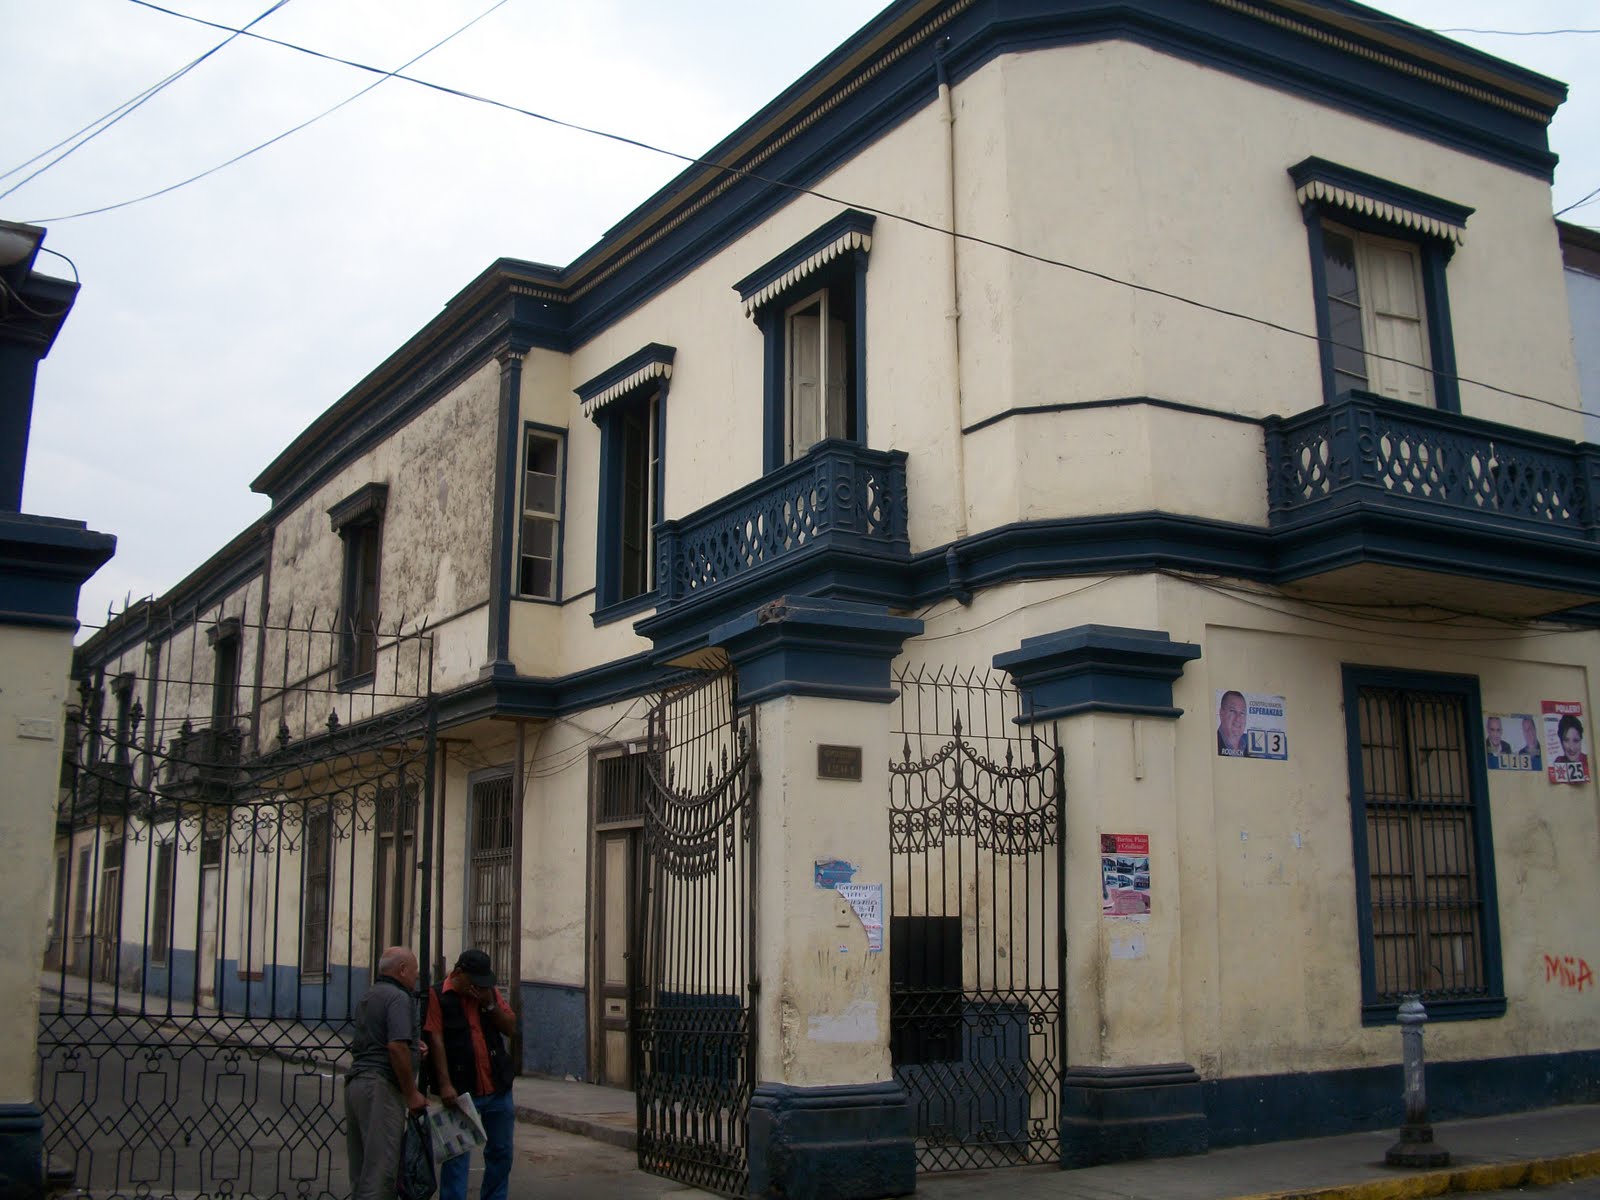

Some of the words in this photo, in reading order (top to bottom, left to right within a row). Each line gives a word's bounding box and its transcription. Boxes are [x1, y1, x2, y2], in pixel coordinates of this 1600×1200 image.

[1249, 707, 1283, 716] ESPERANZAS
[1272, 734, 1280, 752] 3
[1523, 756, 1529, 768] 3
[1568, 764, 1584, 780] 25
